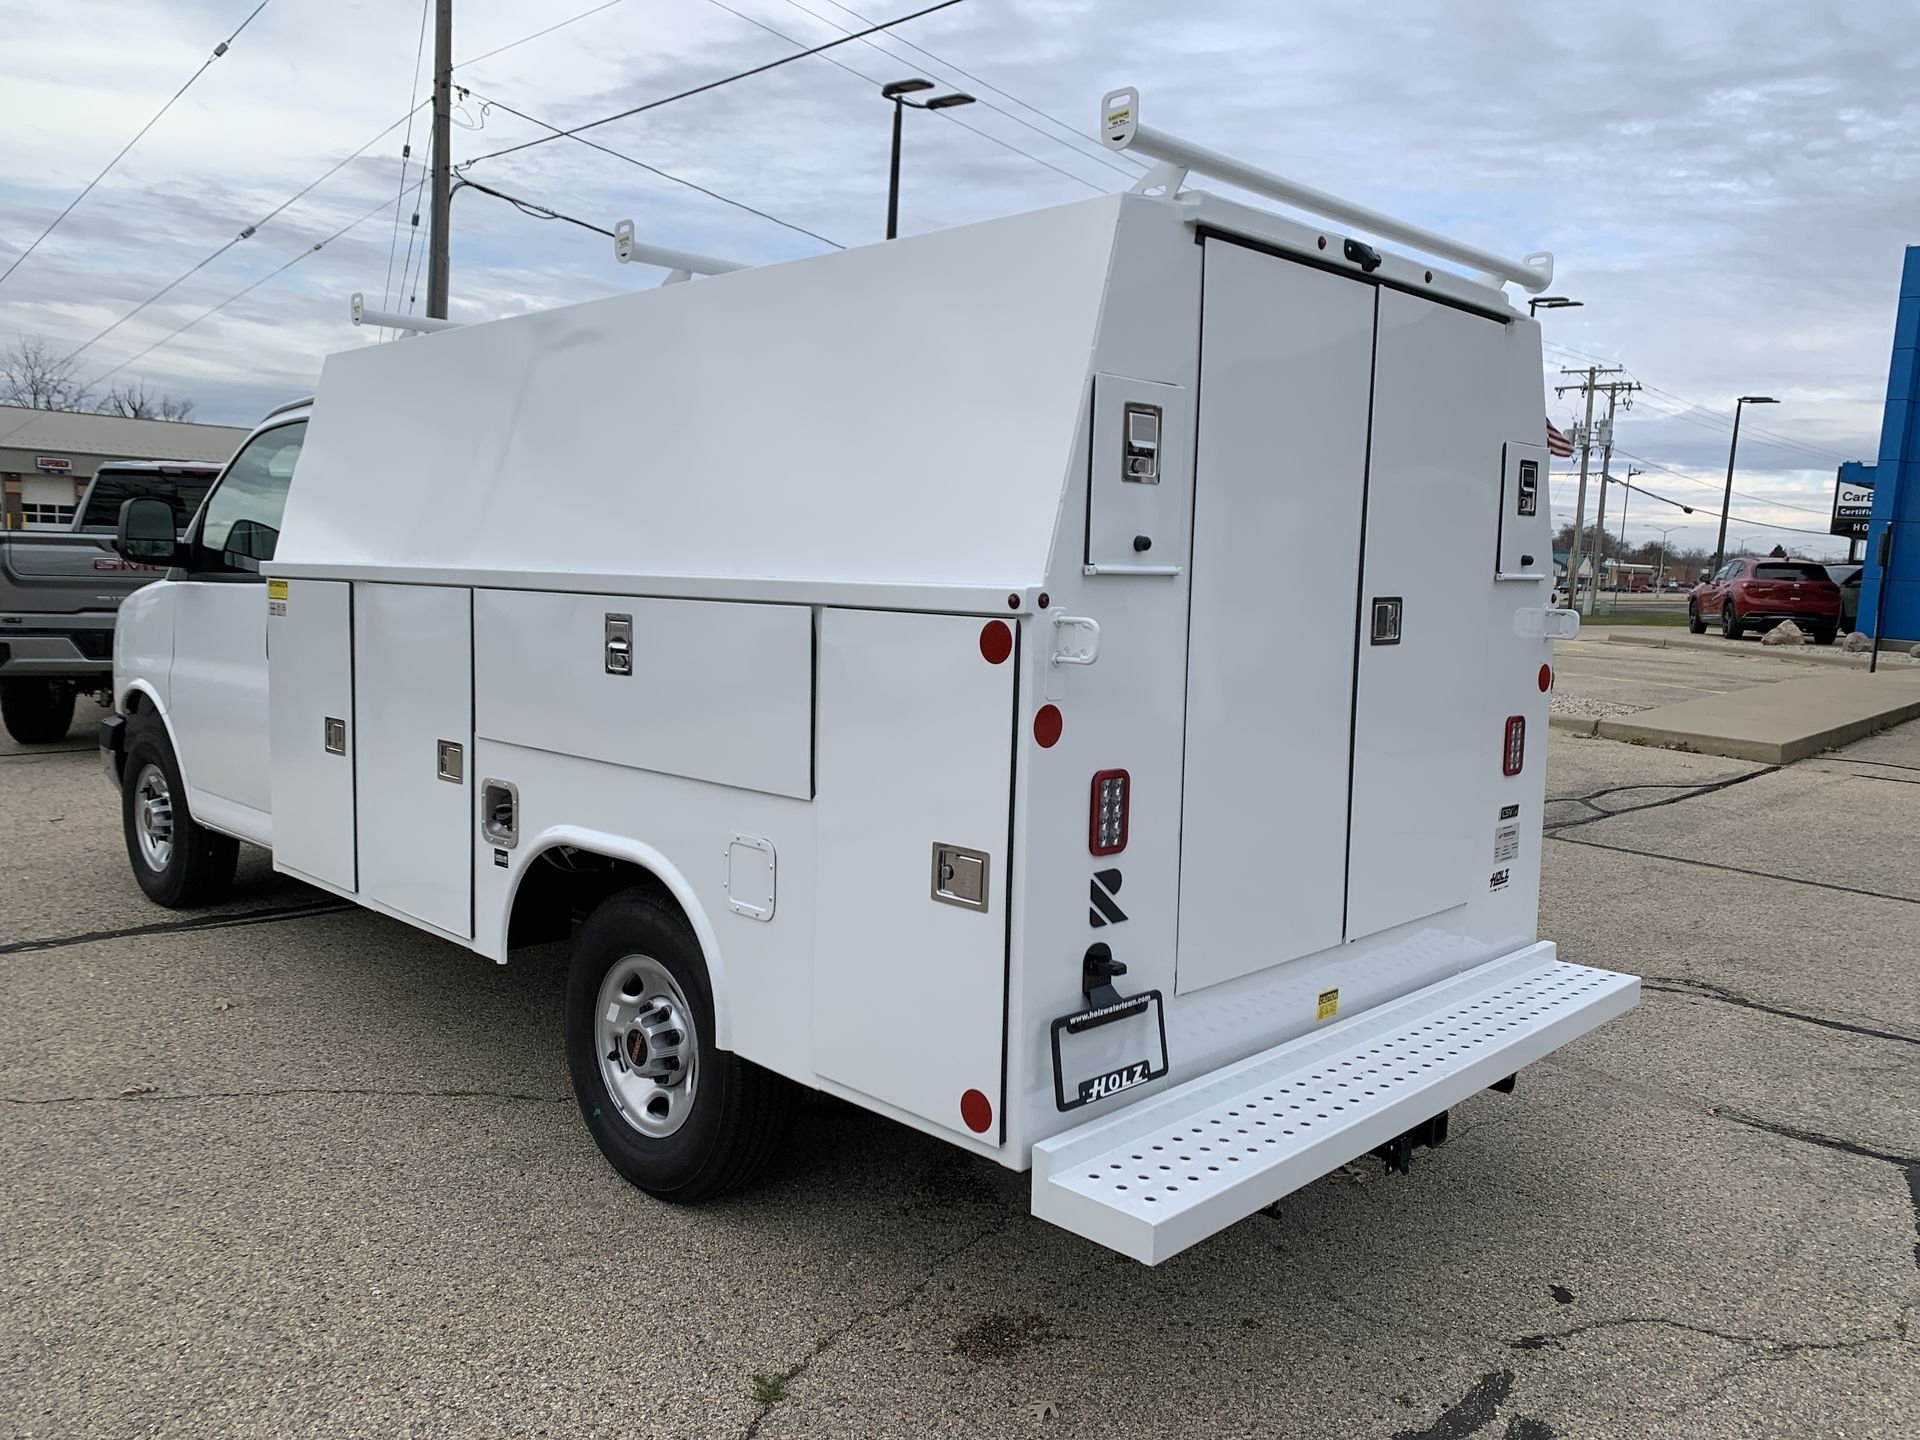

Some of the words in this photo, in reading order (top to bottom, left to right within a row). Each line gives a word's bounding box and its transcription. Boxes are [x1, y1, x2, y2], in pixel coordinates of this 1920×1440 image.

[1853, 523, 1869, 532] HO
[1489, 868, 1510, 888] HOLZ
[1069, 994, 1151, 1025] www.holzwatertown.com
[1087, 1065, 1146, 1102] HOLZ
